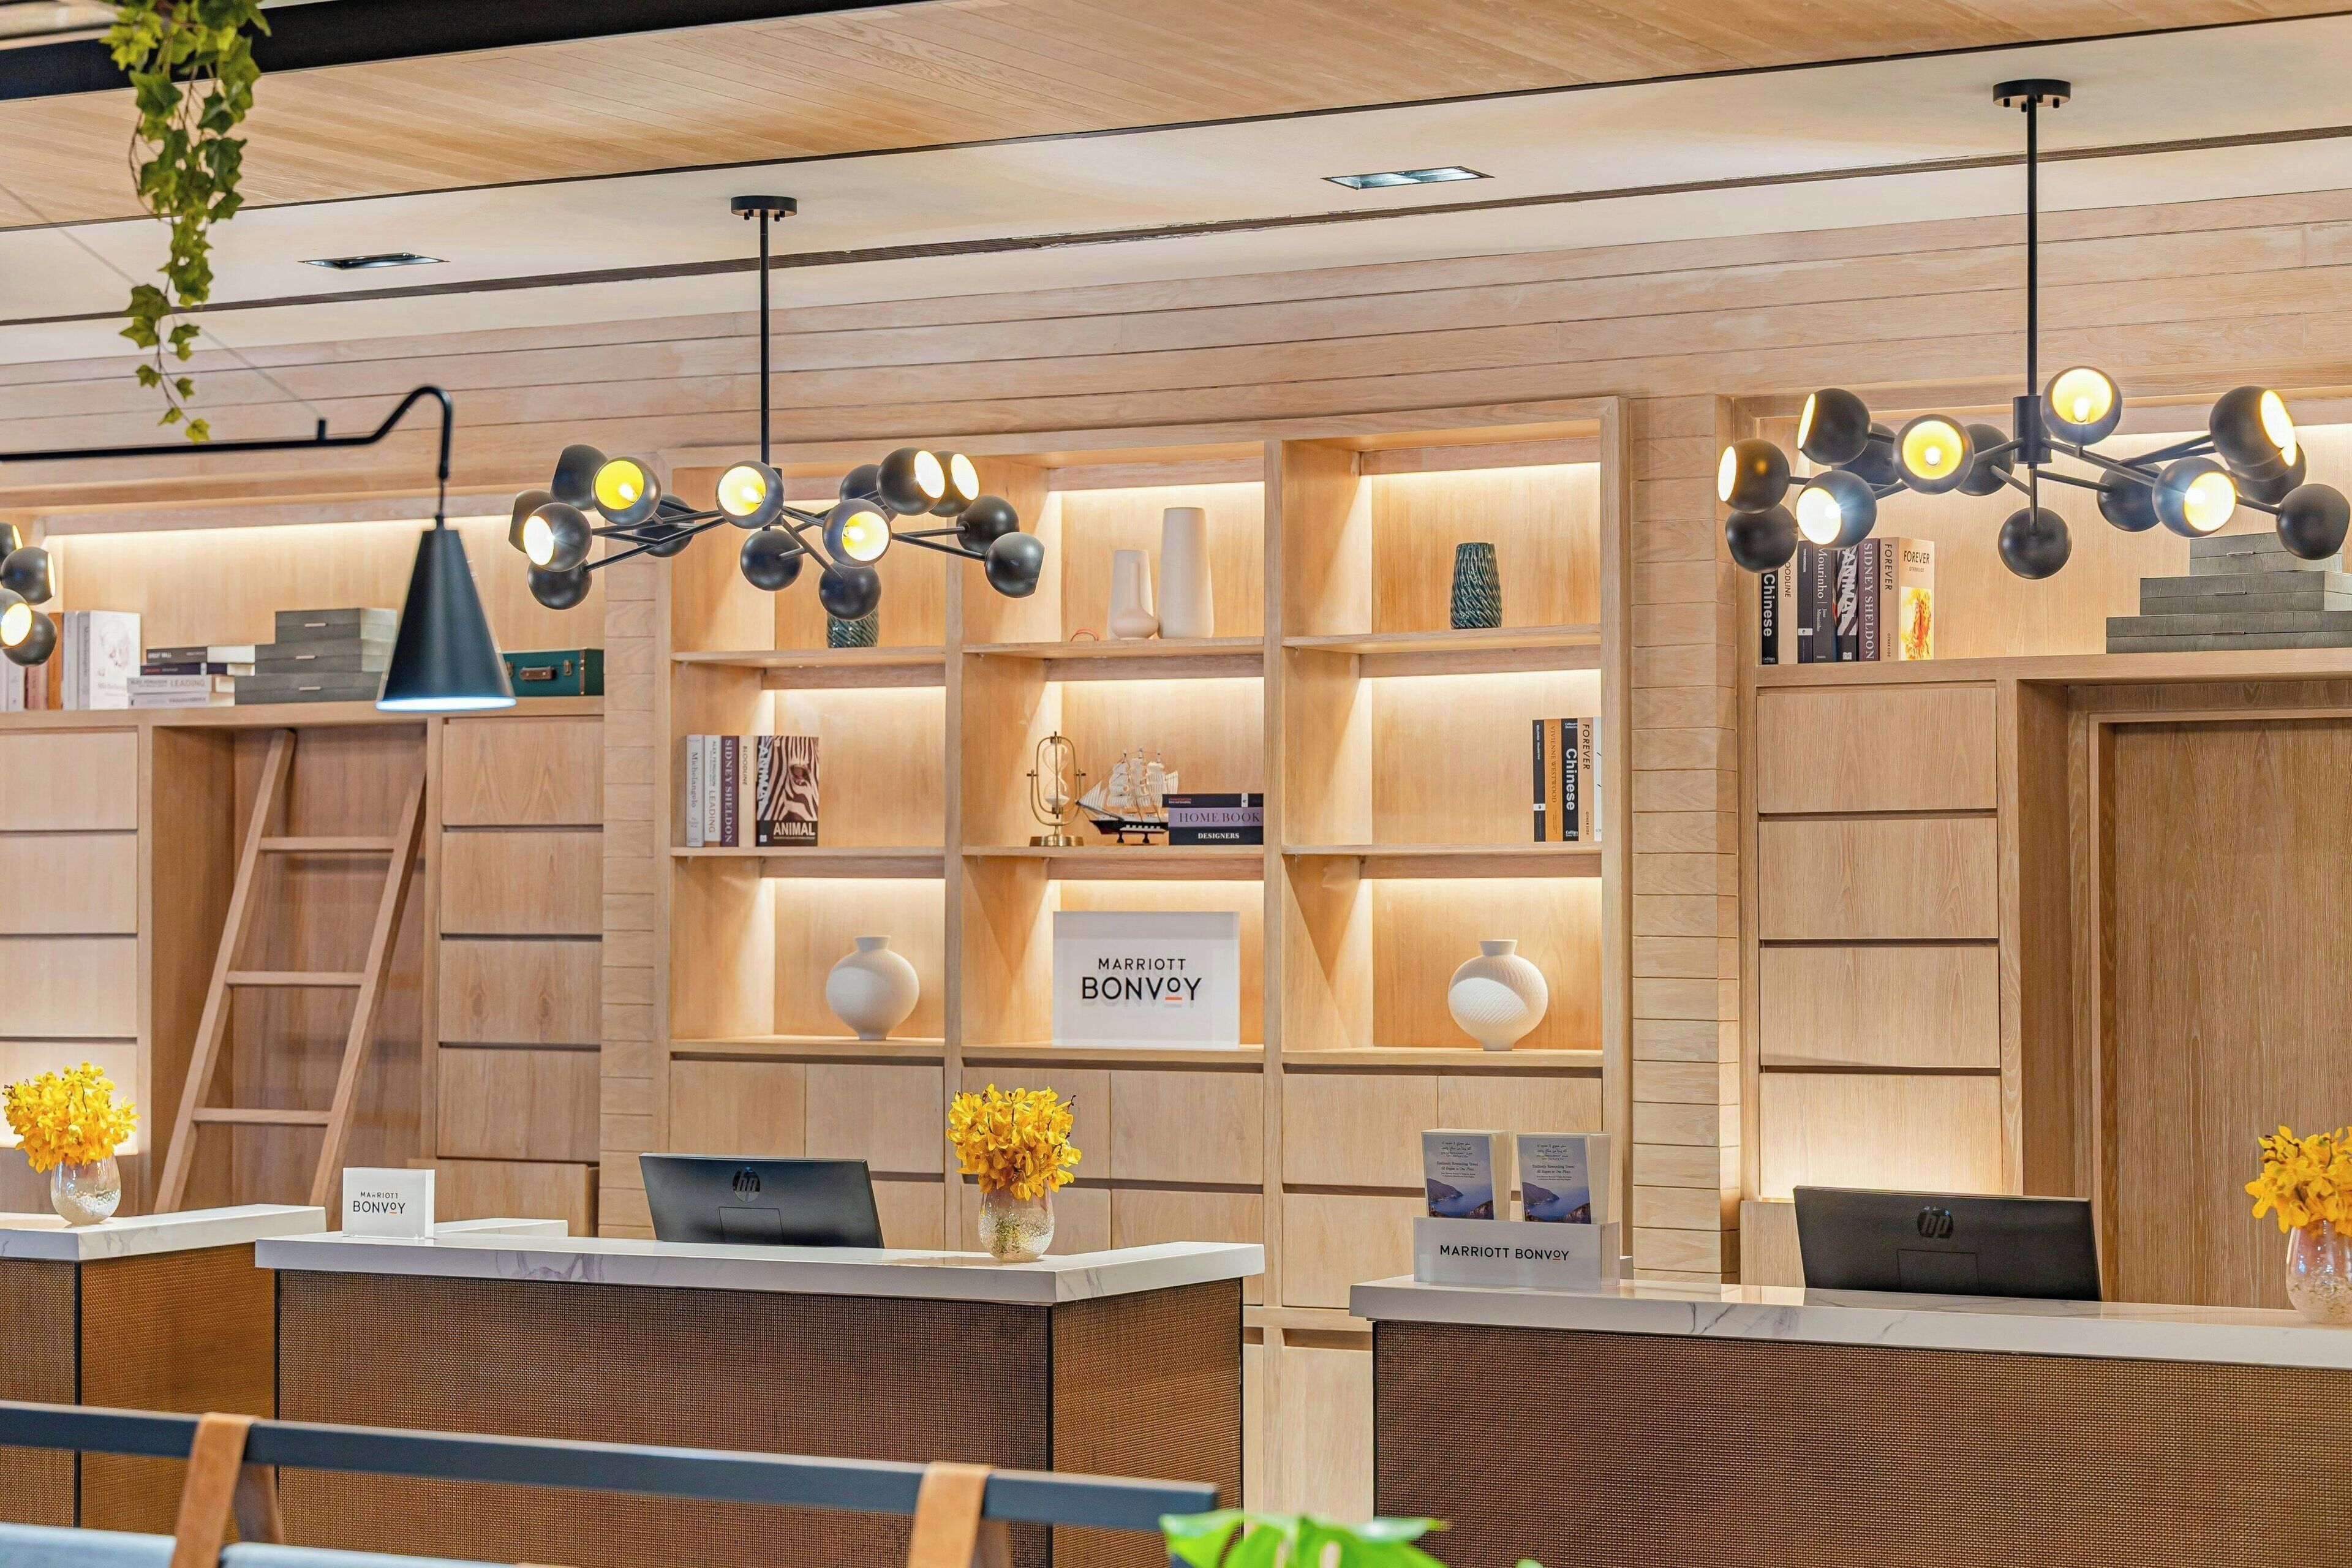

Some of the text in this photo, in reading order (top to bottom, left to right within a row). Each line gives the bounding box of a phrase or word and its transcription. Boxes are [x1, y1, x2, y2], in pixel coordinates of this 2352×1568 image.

[1904, 550, 1929, 564] FOREVER
[1817, 548, 1828, 598] Mourinho
[1842, 551, 1856, 619] ANIMAL
[1763, 574, 1776, 637] Chinese
[1864, 543, 1875, 660] SIDNEY SHELDON
[170, 679, 205, 688] LEADING
[1566, 748, 1577, 810] Chinese
[773, 822, 816, 836] ANIMAL
[1180, 812, 1261, 823] HOME BOOK
[1098, 957, 1186, 971] MARRIOTT
[1082, 976, 1202, 1001] BONVOY
[734, 1167, 760, 1202] hp
[353, 1200, 405, 1214] BONVOY
[1919, 1208, 1952, 1239] hp
[1440, 1245, 1569, 1261] MARRIOTT BONVOY
